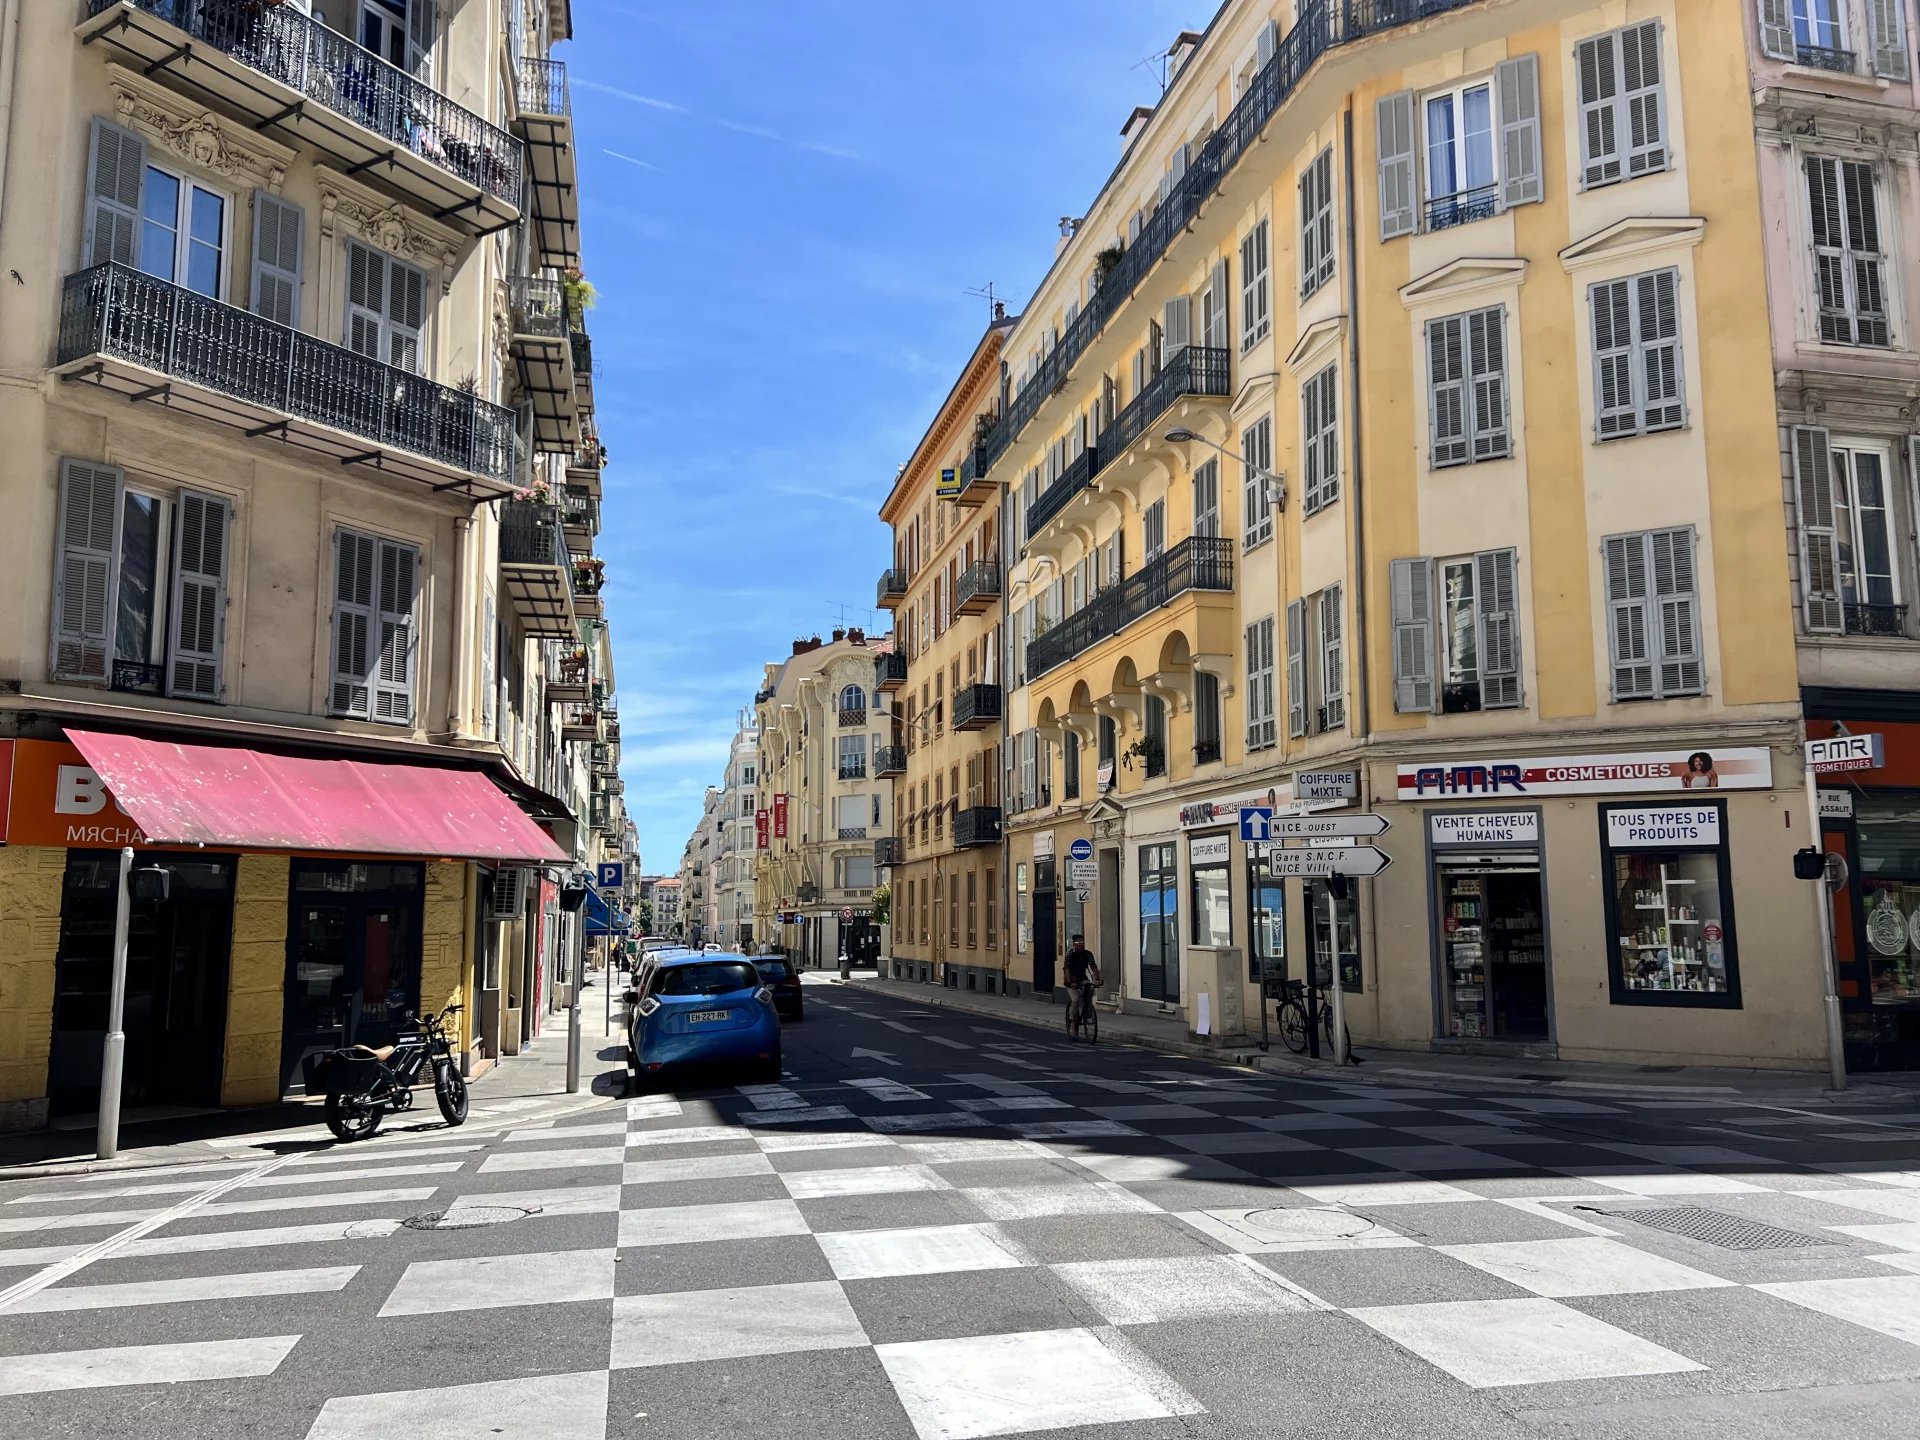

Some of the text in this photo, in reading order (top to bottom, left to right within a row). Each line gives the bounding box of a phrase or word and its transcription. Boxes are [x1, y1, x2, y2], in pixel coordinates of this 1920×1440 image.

[1811, 738, 1869, 761] AMR
[1814, 759, 1870, 772] OSMETIQUES
[1299, 774, 1352, 784] COIFFURE
[1417, 763, 1672, 795] AMR COSMETIQUES
[1311, 787, 1343, 797] MIXTE
[1828, 794, 1840, 802] RUE
[1820, 805, 1849, 813] ASSALIT
[1435, 814, 1534, 829] VENTE CHEVEUX
[1610, 811, 1716, 826] TOUS TYPES DE
[66, 825, 146, 844] МЯСНА
[1273, 823, 1301, 833] NICE
[1629, 827, 1698, 840] PRODUITS
[1457, 829, 1513, 841] HUMAINS
[1193, 842, 1227, 857] COIFFURE MIXTE
[1275, 851, 1348, 862] Gare S.N.C.F.
[1275, 863, 1300, 873] NICE
[604, 867, 616, 884] P
